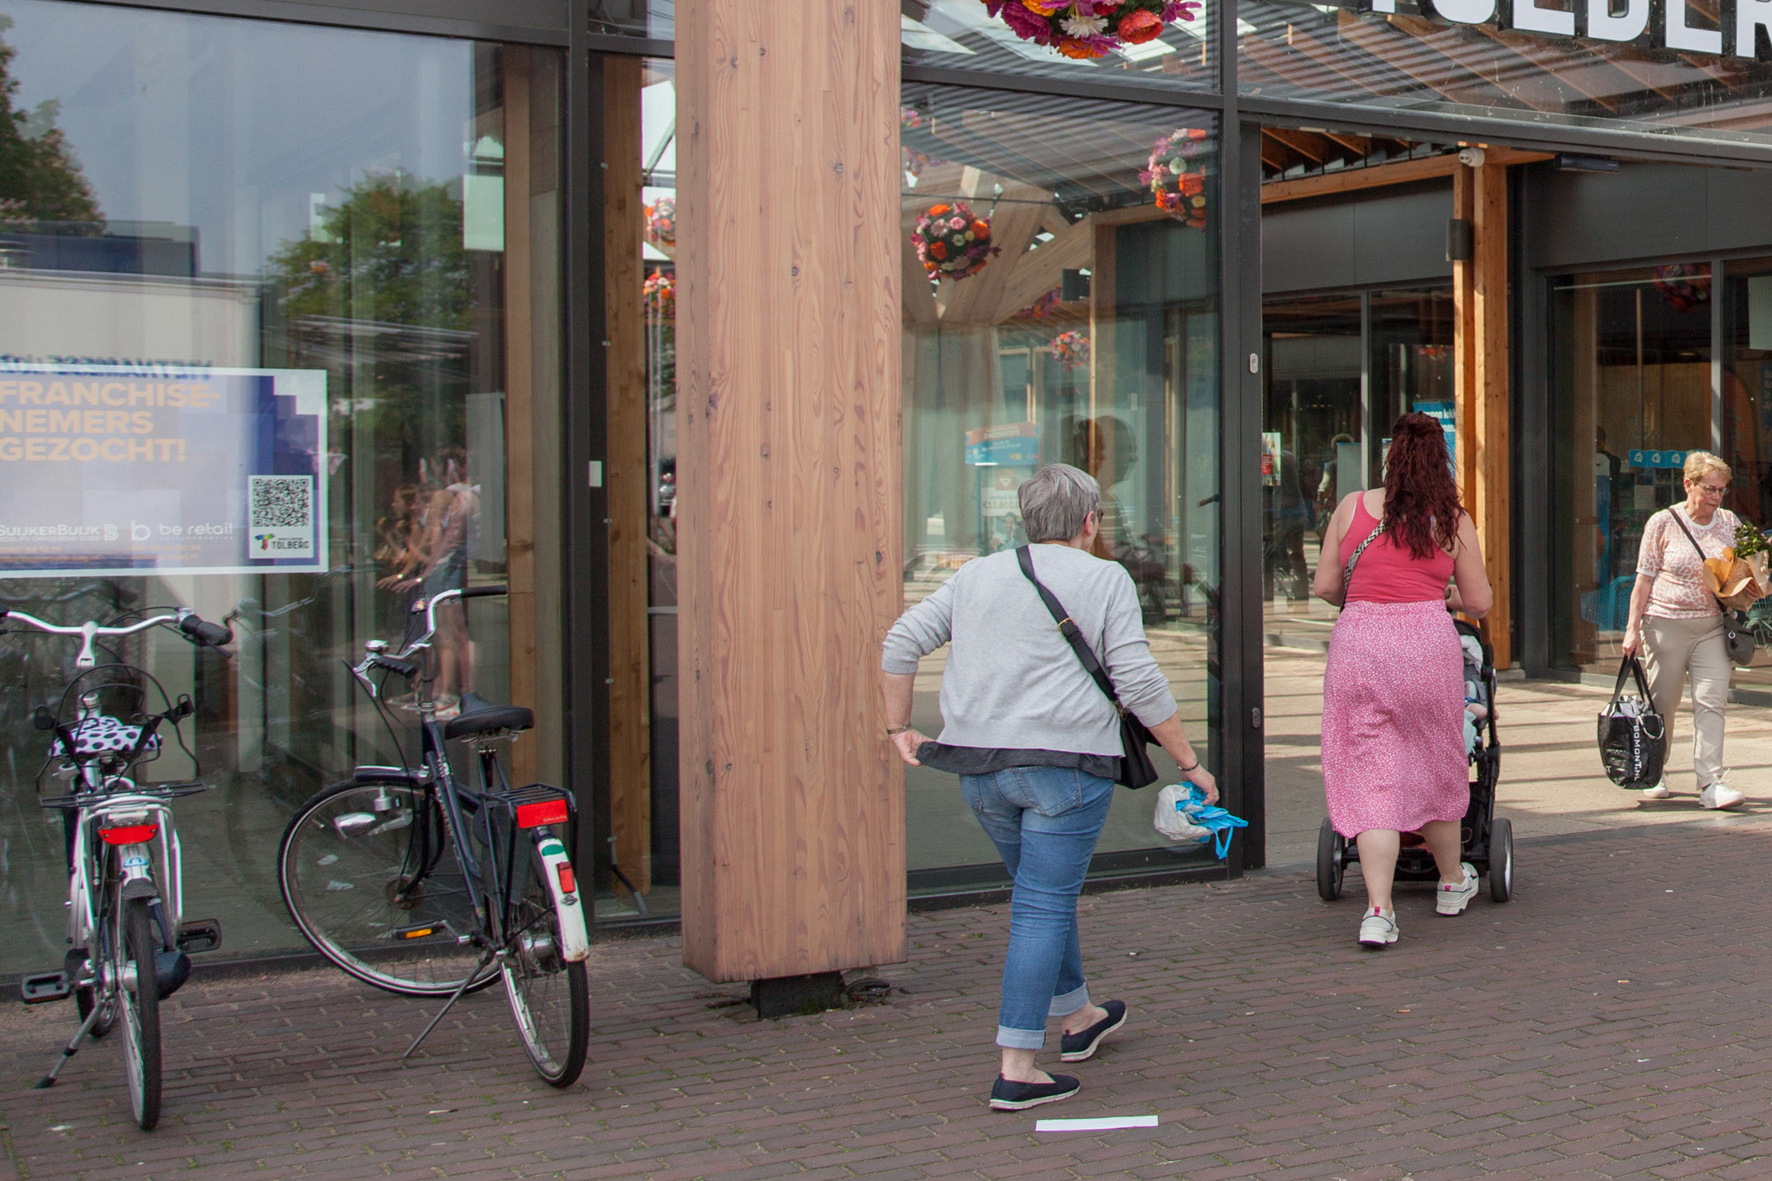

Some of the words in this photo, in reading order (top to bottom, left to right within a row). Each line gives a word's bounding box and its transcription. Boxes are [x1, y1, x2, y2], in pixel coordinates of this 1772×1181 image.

[0, 381, 220, 407] FRANCHISE-
[0, 409, 154, 434] NEMERS
[0, 437, 187, 462] GEZOCHT!
[159, 523, 183, 536] be
[187, 522, 234, 535] retail
[272, 540, 310, 550] TOLBERG
